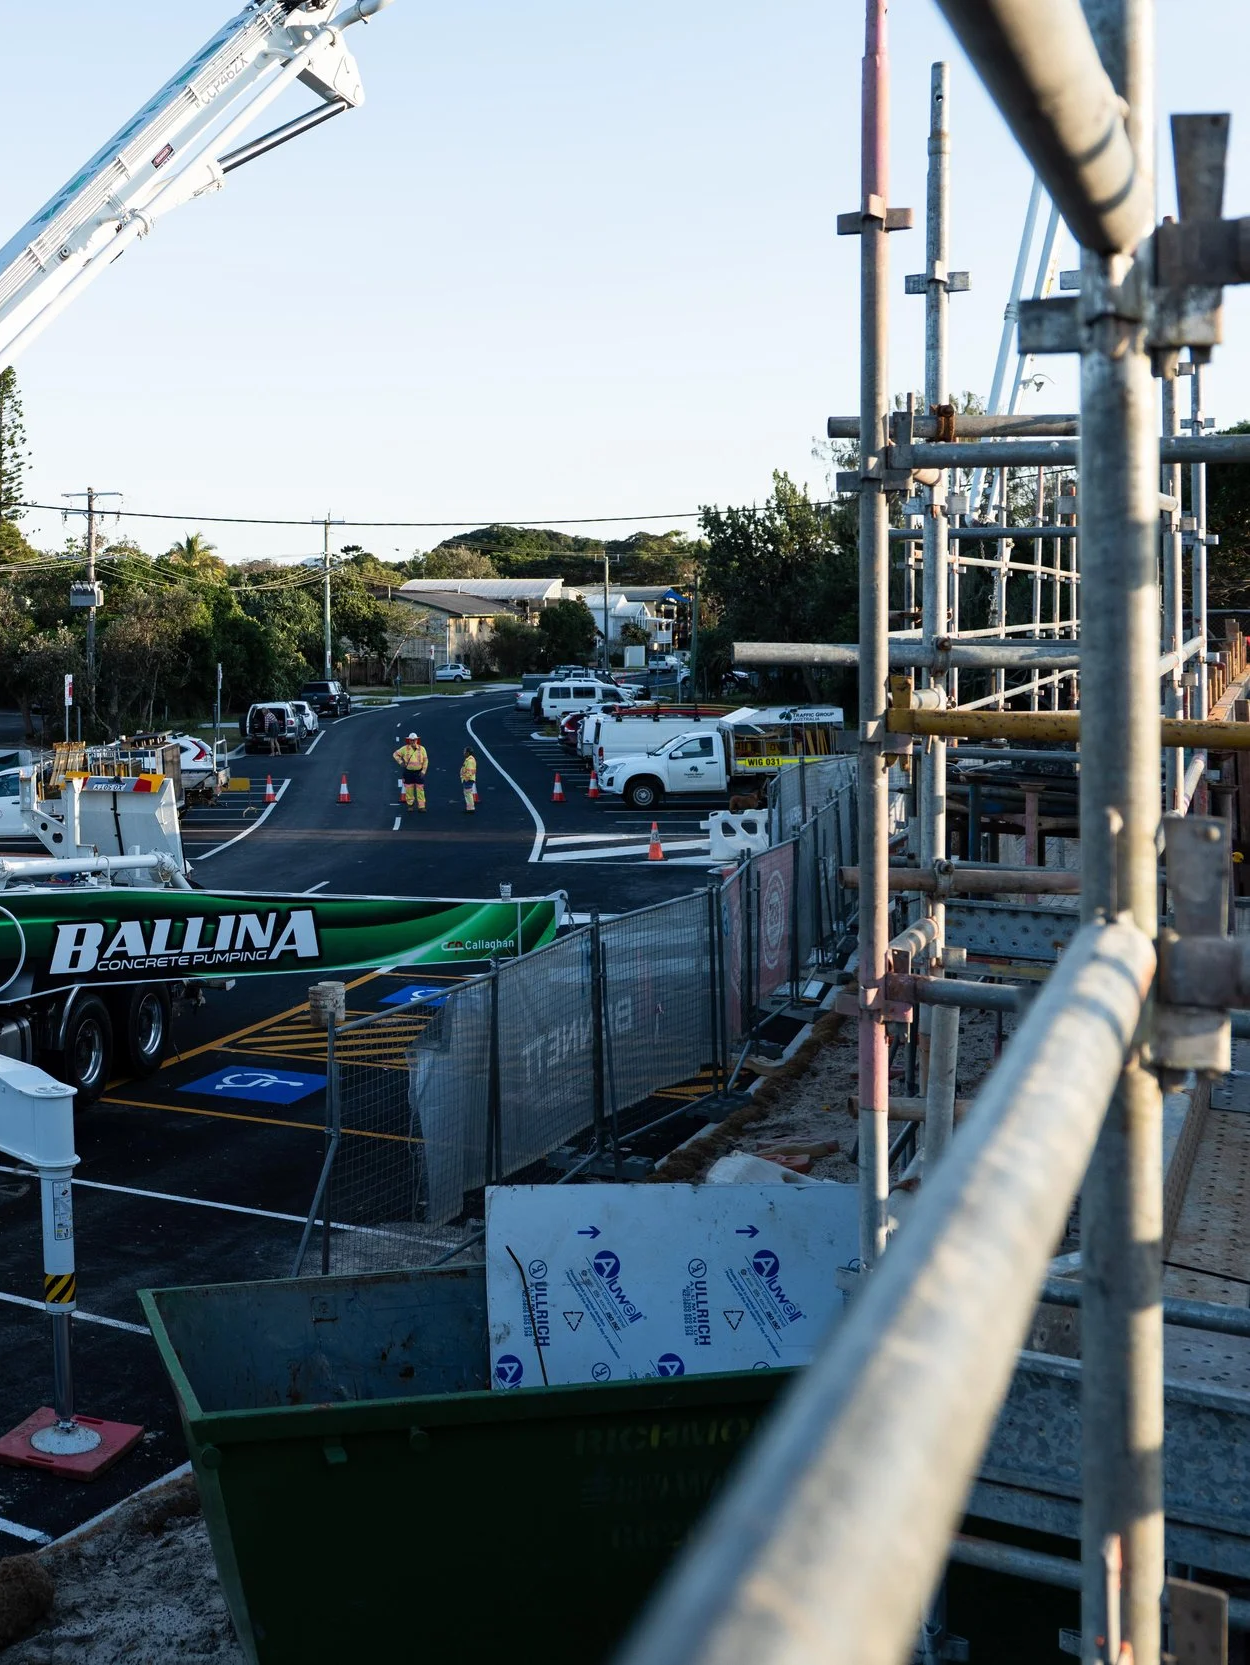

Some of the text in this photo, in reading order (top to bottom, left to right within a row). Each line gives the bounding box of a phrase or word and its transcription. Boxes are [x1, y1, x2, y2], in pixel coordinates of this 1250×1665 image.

[747, 758, 780, 766] WIG 031
[49, 909, 319, 975] BALLINA
[96, 950, 268, 972] CONCRETE PUMPING
[464, 938, 514, 952] Callaghan
[534, 1280, 550, 1347] ULLRICH
[595, 1250, 643, 1323] Aluwell
[694, 1280, 712, 1346] ULLRICH
[753, 1250, 803, 1323] Aluwell
